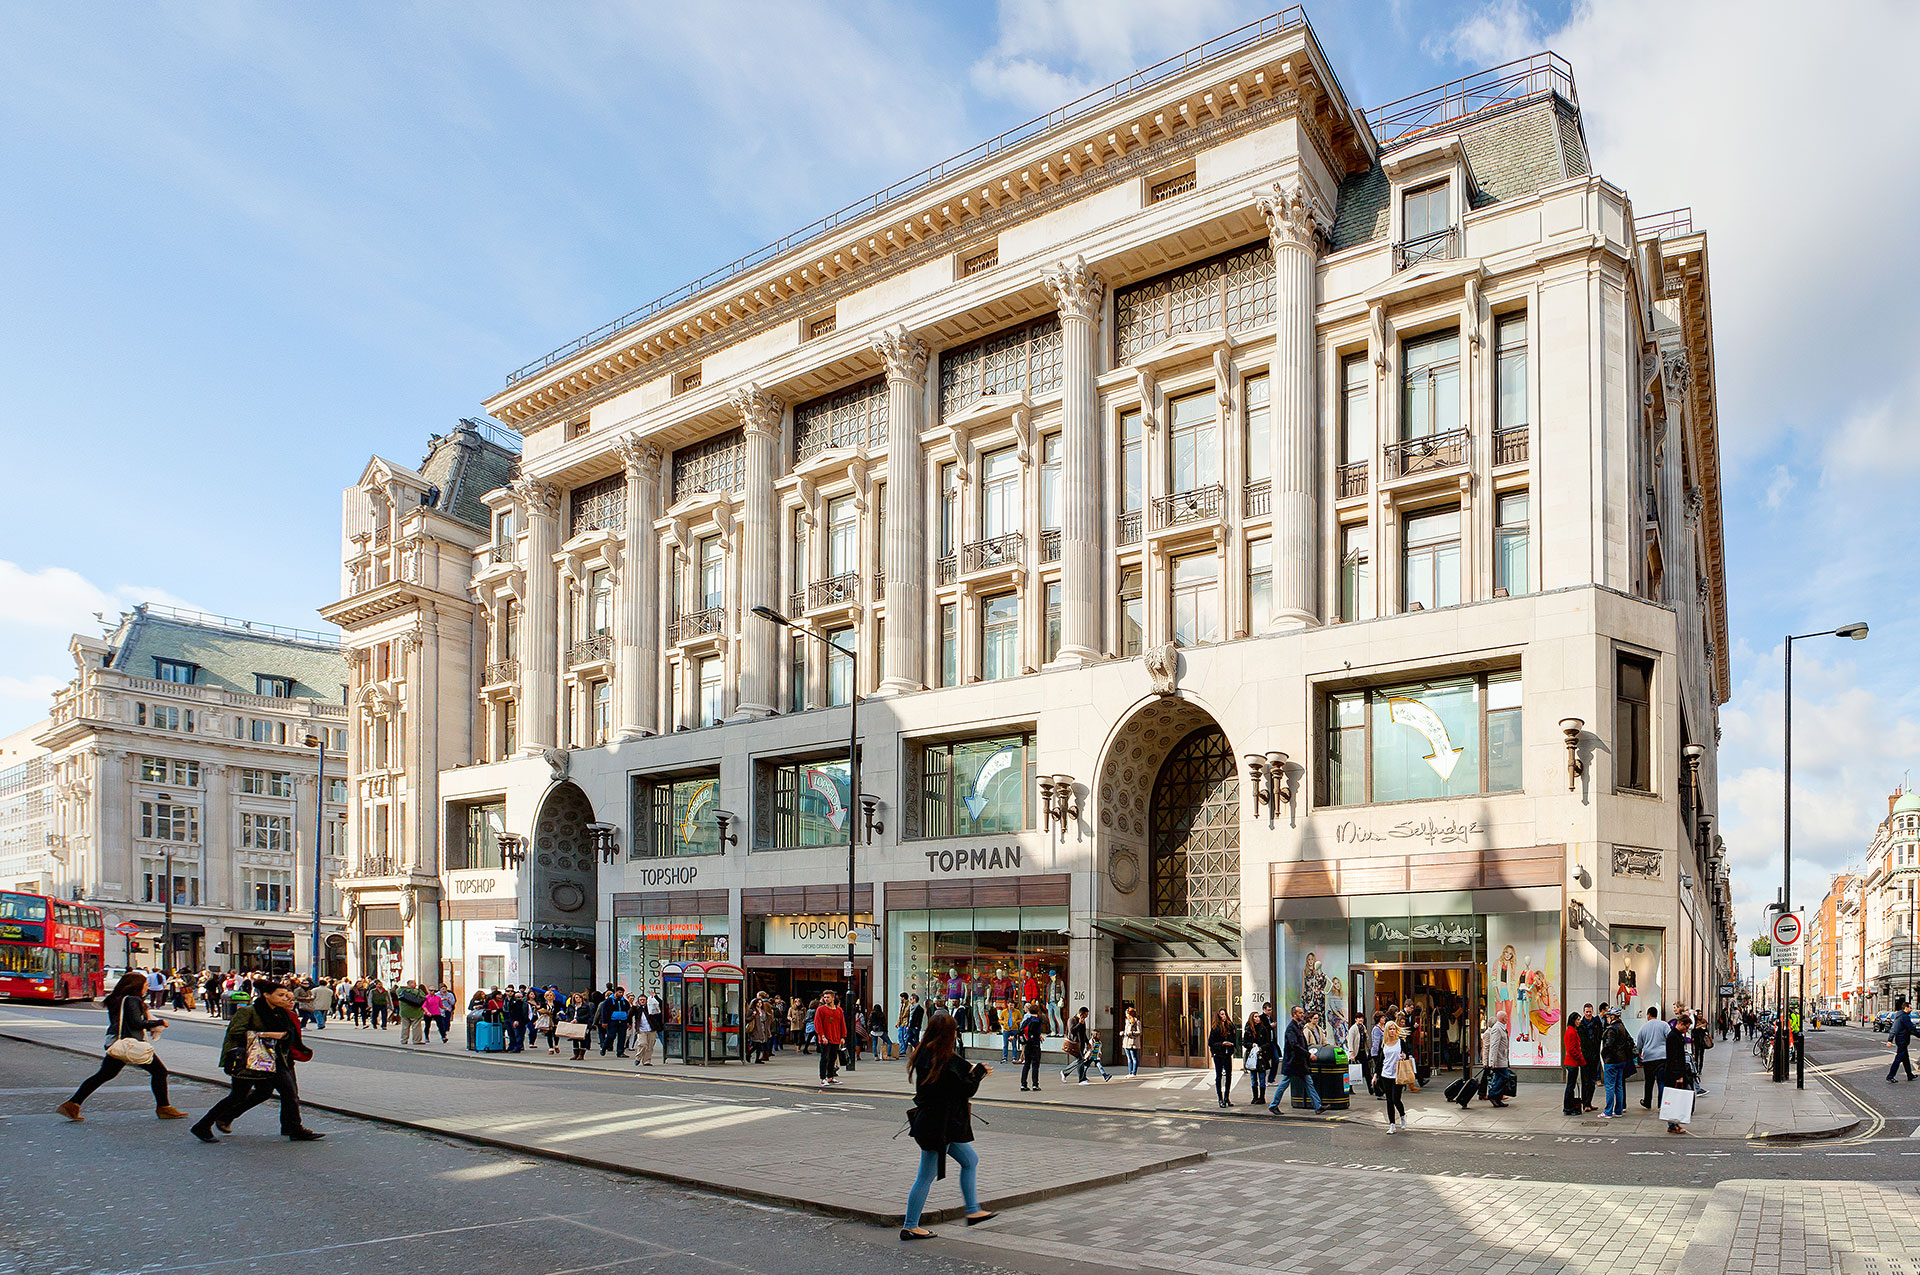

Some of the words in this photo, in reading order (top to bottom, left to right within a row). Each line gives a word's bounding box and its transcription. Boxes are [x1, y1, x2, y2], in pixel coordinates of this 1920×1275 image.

[1336, 821, 1386, 844] Miss
[1388, 816, 1484, 846] Selfridge
[925, 846, 1020, 872] TOPMAN
[455, 878, 495, 894] TOPSHOP
[640, 867, 697, 886] TOPSHOP
[790, 921, 848, 940] TOPSHO
[1369, 922, 1409, 940] Miss
[1410, 921, 1482, 945] Selfridge
[649, 950, 661, 996] TOPSH
[1074, 991, 1085, 1001] 216
[1234, 995, 1242, 1006] 21
[1252, 992, 1265, 1003] 216
